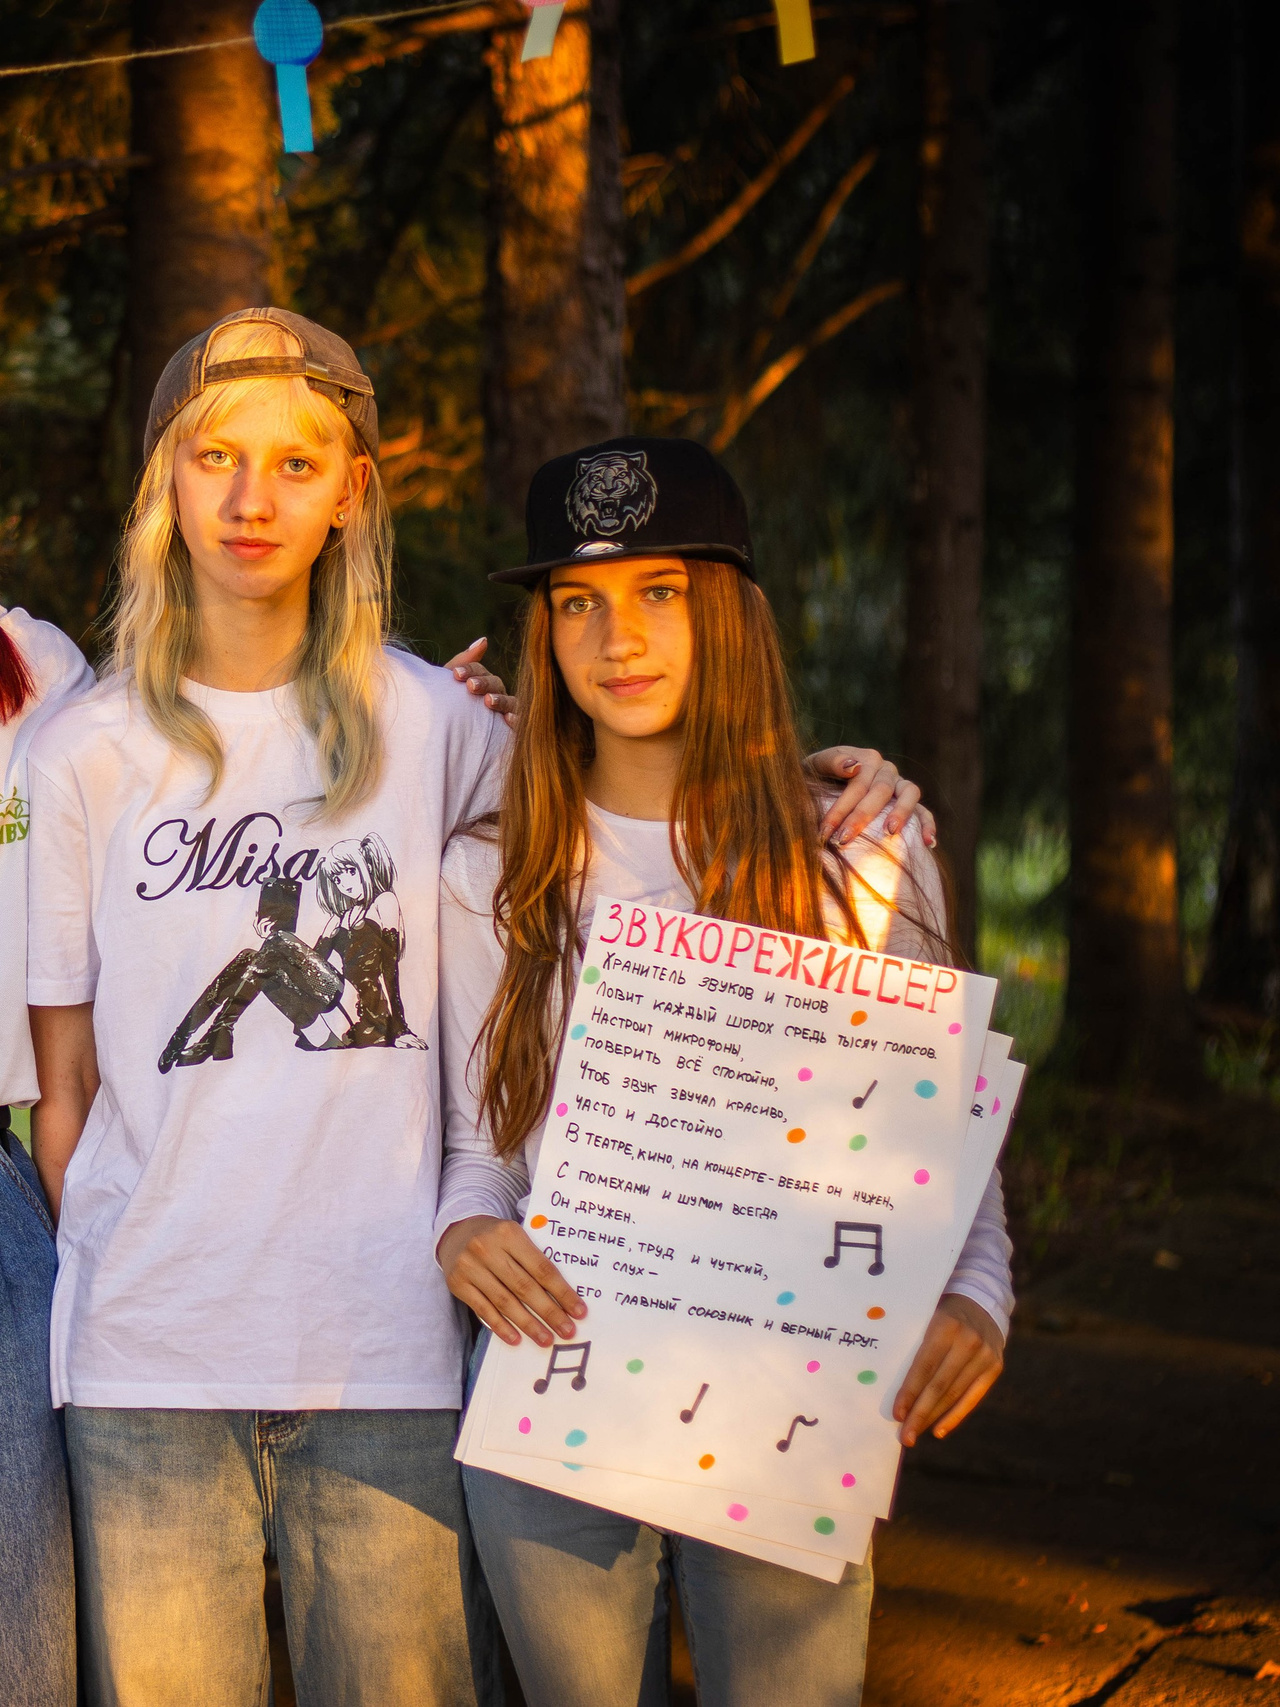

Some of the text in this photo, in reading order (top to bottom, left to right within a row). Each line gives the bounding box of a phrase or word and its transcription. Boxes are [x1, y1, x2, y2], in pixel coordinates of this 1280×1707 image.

[136, 811, 325, 900] Misa
[599, 903, 958, 1014] ЗВУКОРЕЖИССЁР
[602, 951, 829, 1014] ХРАНИТЕЛЬ ЗВУКОВ И ТОНОВ
[591, 1005, 744, 1062] НАСТРОИТ МИКРОФОНЫ,
[596, 981, 937, 1060] ЛОВИТ КАЖДЫЙ ШОРОХ СРЕДЬ ТЫСЯЧ ГОЛОСОВ.
[580, 1059, 788, 1124] ЧТОБ ЗВУК ЗВУЧАЛ КРАСИВО,
[584, 1036, 779, 1092] ПОВЕРИТЬ ВСЁ СПОКОЙНО,
[575, 1094, 616, 1118] ЧАСТО
[625, 1109, 636, 1122] И
[556, 1161, 779, 1221] С ПОМЕХАМИ И ШУМОМ ВСЕГДА
[565, 1122, 580, 1143] В
[682, 1158, 699, 1171] НА
[777, 1175, 820, 1193] ВЕЗДЕ
[826, 1185, 842, 1197] ОН
[852, 1190, 894, 1211] НУЖЕН,
[574, 1200, 636, 1225] ДРУЖЕН.
[637, 1241, 675, 1261] ТРУД
[691, 1254, 701, 1265] И
[710, 1257, 769, 1281] ЧУТКИЙ,
[576, 1285, 879, 1349] ЕГО ГЛАВНЫЙ СОЮЗНИК И ВЕРНЫЙ ДРУГ.
